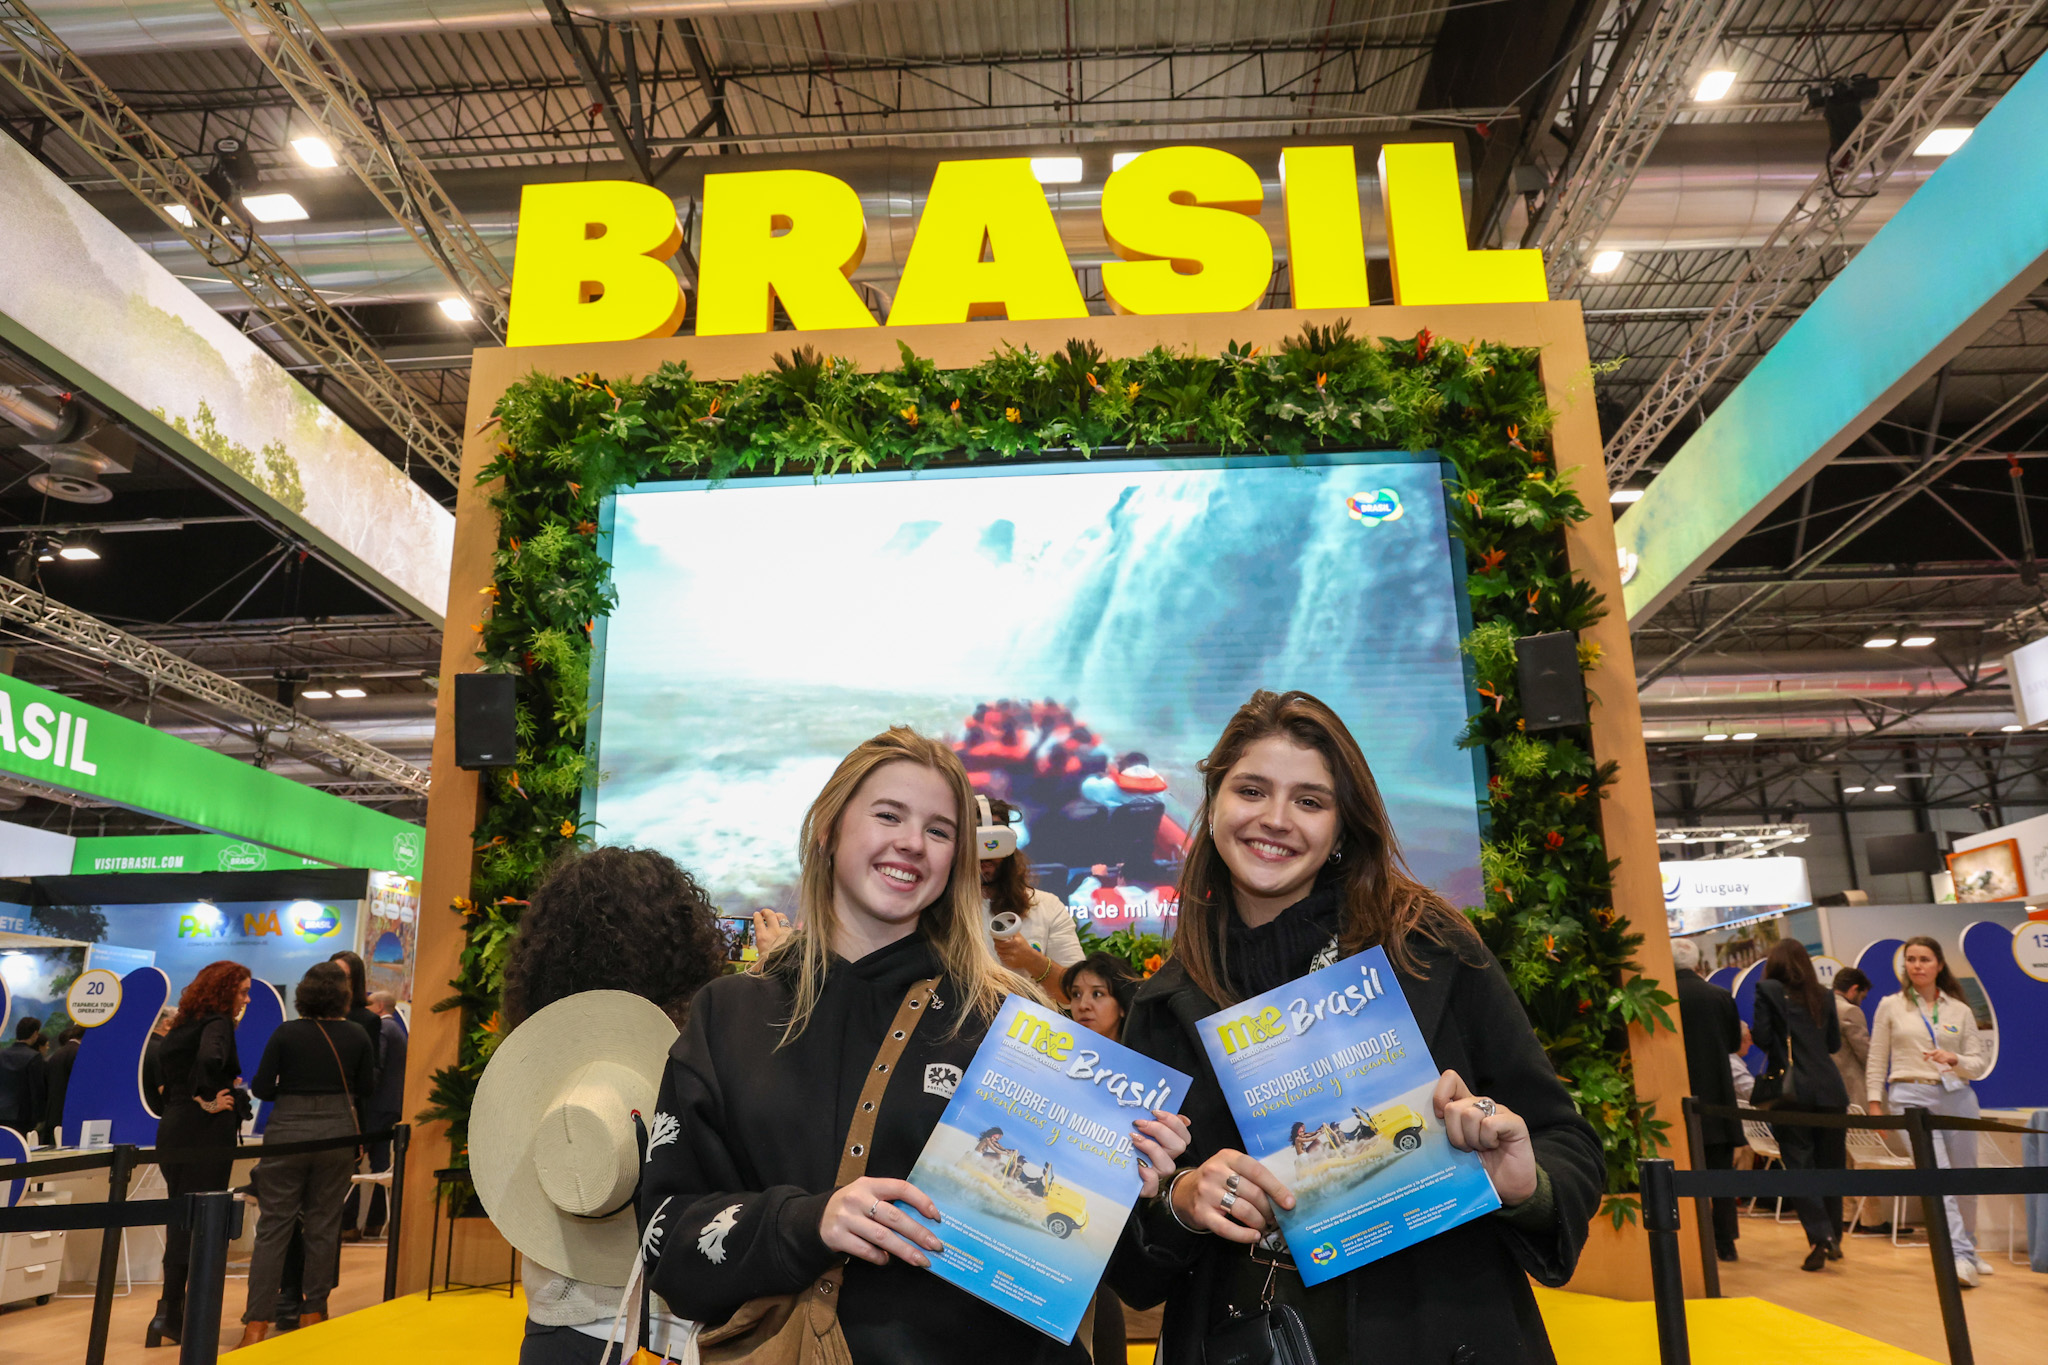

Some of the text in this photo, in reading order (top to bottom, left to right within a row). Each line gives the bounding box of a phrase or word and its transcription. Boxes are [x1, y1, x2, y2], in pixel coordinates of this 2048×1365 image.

[506, 142, 1549, 347] BRASIL
[1360, 503, 1391, 513] BRASIL
[95, 856, 183, 870] VISITBRASIL.COM
[1695, 883, 1750, 896] Uruguay
[1065, 905, 1089, 919] ra
[1094, 901, 1119, 918] de
[1124, 901, 1147, 917] mi
[305, 920, 331, 929] BRASIL
[1820, 966, 1832, 976] 11
[86, 982, 105, 995] 20
[1287, 965, 1384, 1036] Brasil
[1243, 1066, 1313, 1107] DESCUBRE
[1311, 1056, 1333, 1077] UN
[1334, 1037, 1381, 1070] MUNDO
[1379, 1028, 1401, 1051] DE
[1065, 1050, 1171, 1111] Brasil
[1252, 1046, 1406, 1118] aventuras y encantos
[981, 1069, 1050, 1115] DESCUBRE
[1048, 1103, 1070, 1126] UN
[1068, 1113, 1118, 1148] MUNDO
[1116, 1136, 1137, 1158] DE
[975, 1087, 1048, 1130] aventuras
[1045, 1127, 1060, 1146] y
[1066, 1135, 1130, 1170] encantos
[1317, 1249, 1331, 1258] BRASIL
